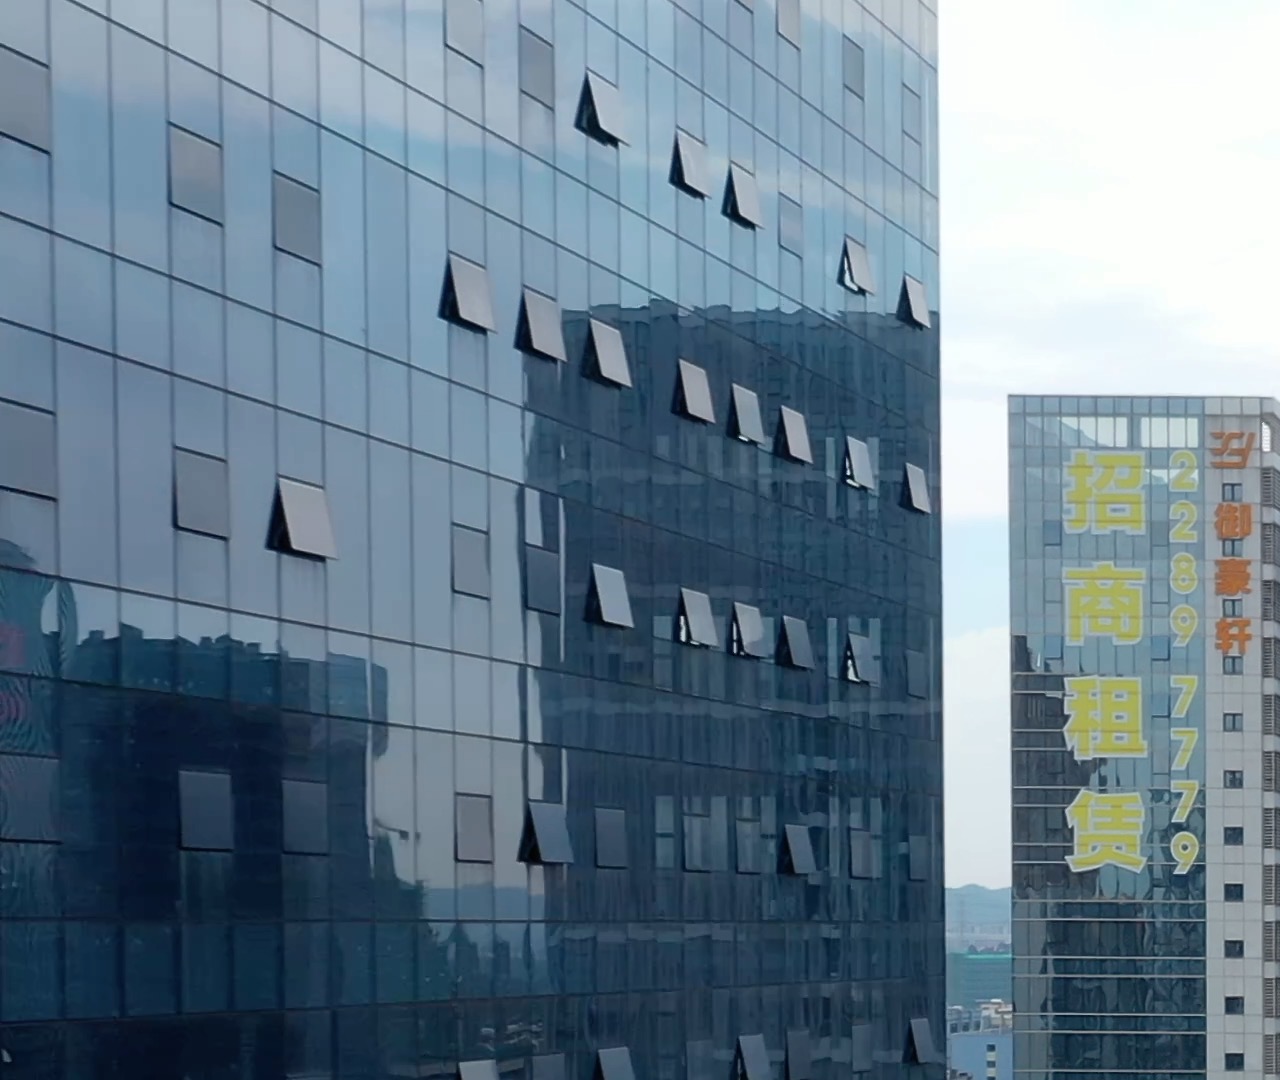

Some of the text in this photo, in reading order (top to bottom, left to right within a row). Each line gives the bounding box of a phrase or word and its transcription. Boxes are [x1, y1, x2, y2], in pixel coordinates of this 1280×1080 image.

[1063, 449, 1147, 873] 招商租赁
[1214, 503, 1253, 654] 御豪轩
